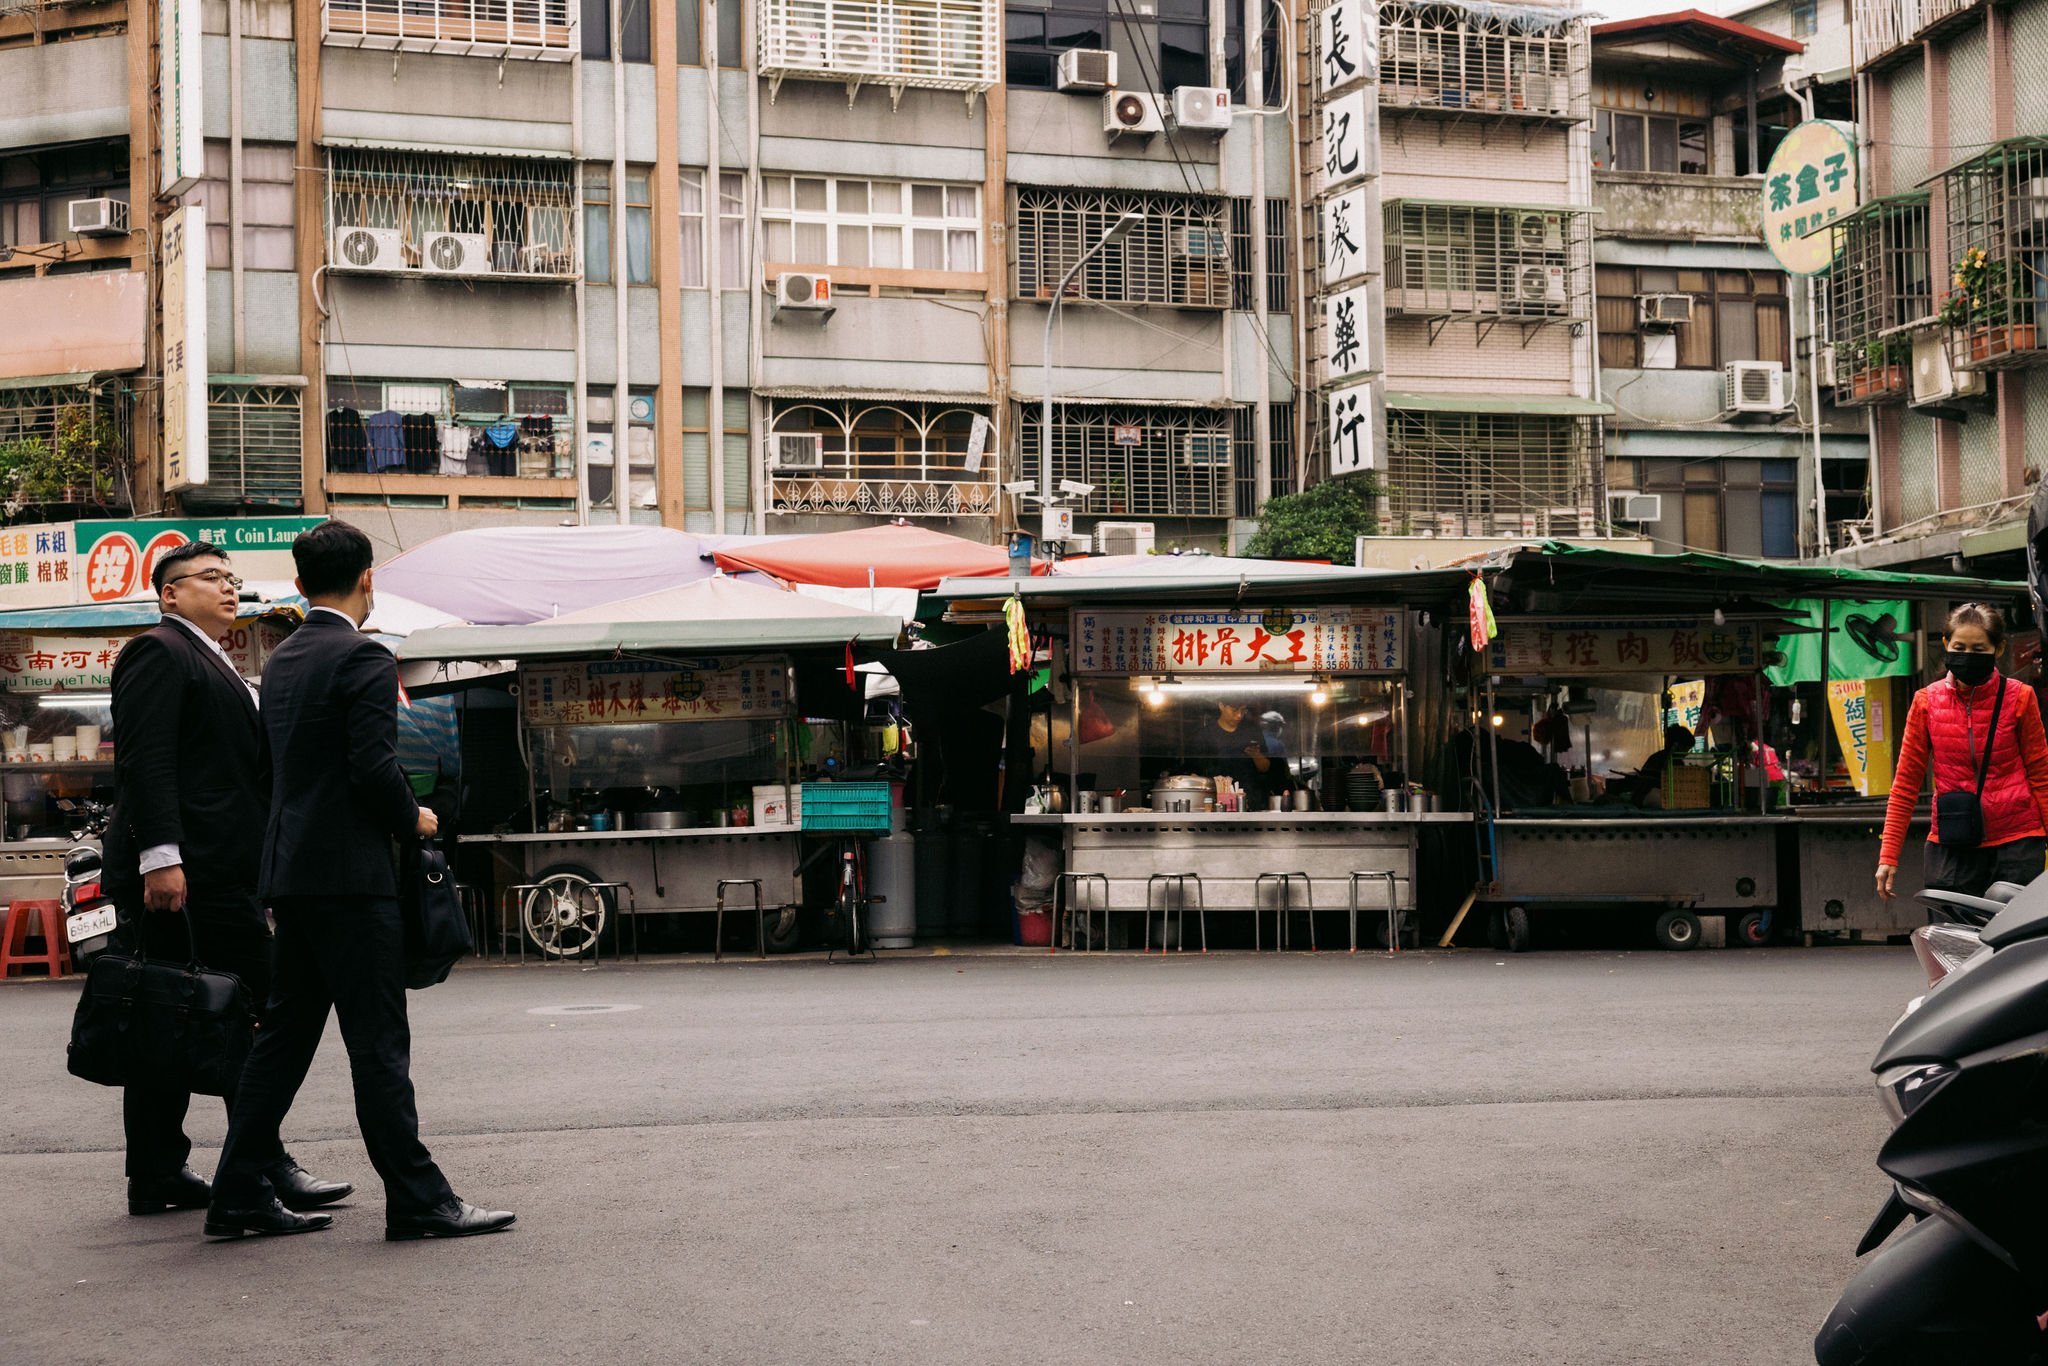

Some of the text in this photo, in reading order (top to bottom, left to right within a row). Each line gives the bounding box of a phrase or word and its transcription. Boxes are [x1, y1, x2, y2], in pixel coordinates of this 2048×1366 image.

[1769, 152, 1848, 212] 茶盒子
[198, 528, 227, 545] 美式
[235, 527, 262, 544] Coin
[36, 531, 67, 554] 床組
[37, 560, 69, 583] 棉被
[1172, 627, 1308, 667] 排骨大王
[1565, 629, 1706, 668] 控肉飯
[1115, 662, 1126, 671] 35
[1128, 662, 1139, 671] 60
[1142, 662, 1153, 671] 70
[1155, 662, 1166, 671] 70
[1312, 661, 1323, 670] 35
[1326, 661, 1337, 670] 35
[1339, 661, 1350, 670] 60
[1352, 661, 1363, 670] 70
[1367, 661, 1378, 670] 70
[91, 674, 112, 685] Na
